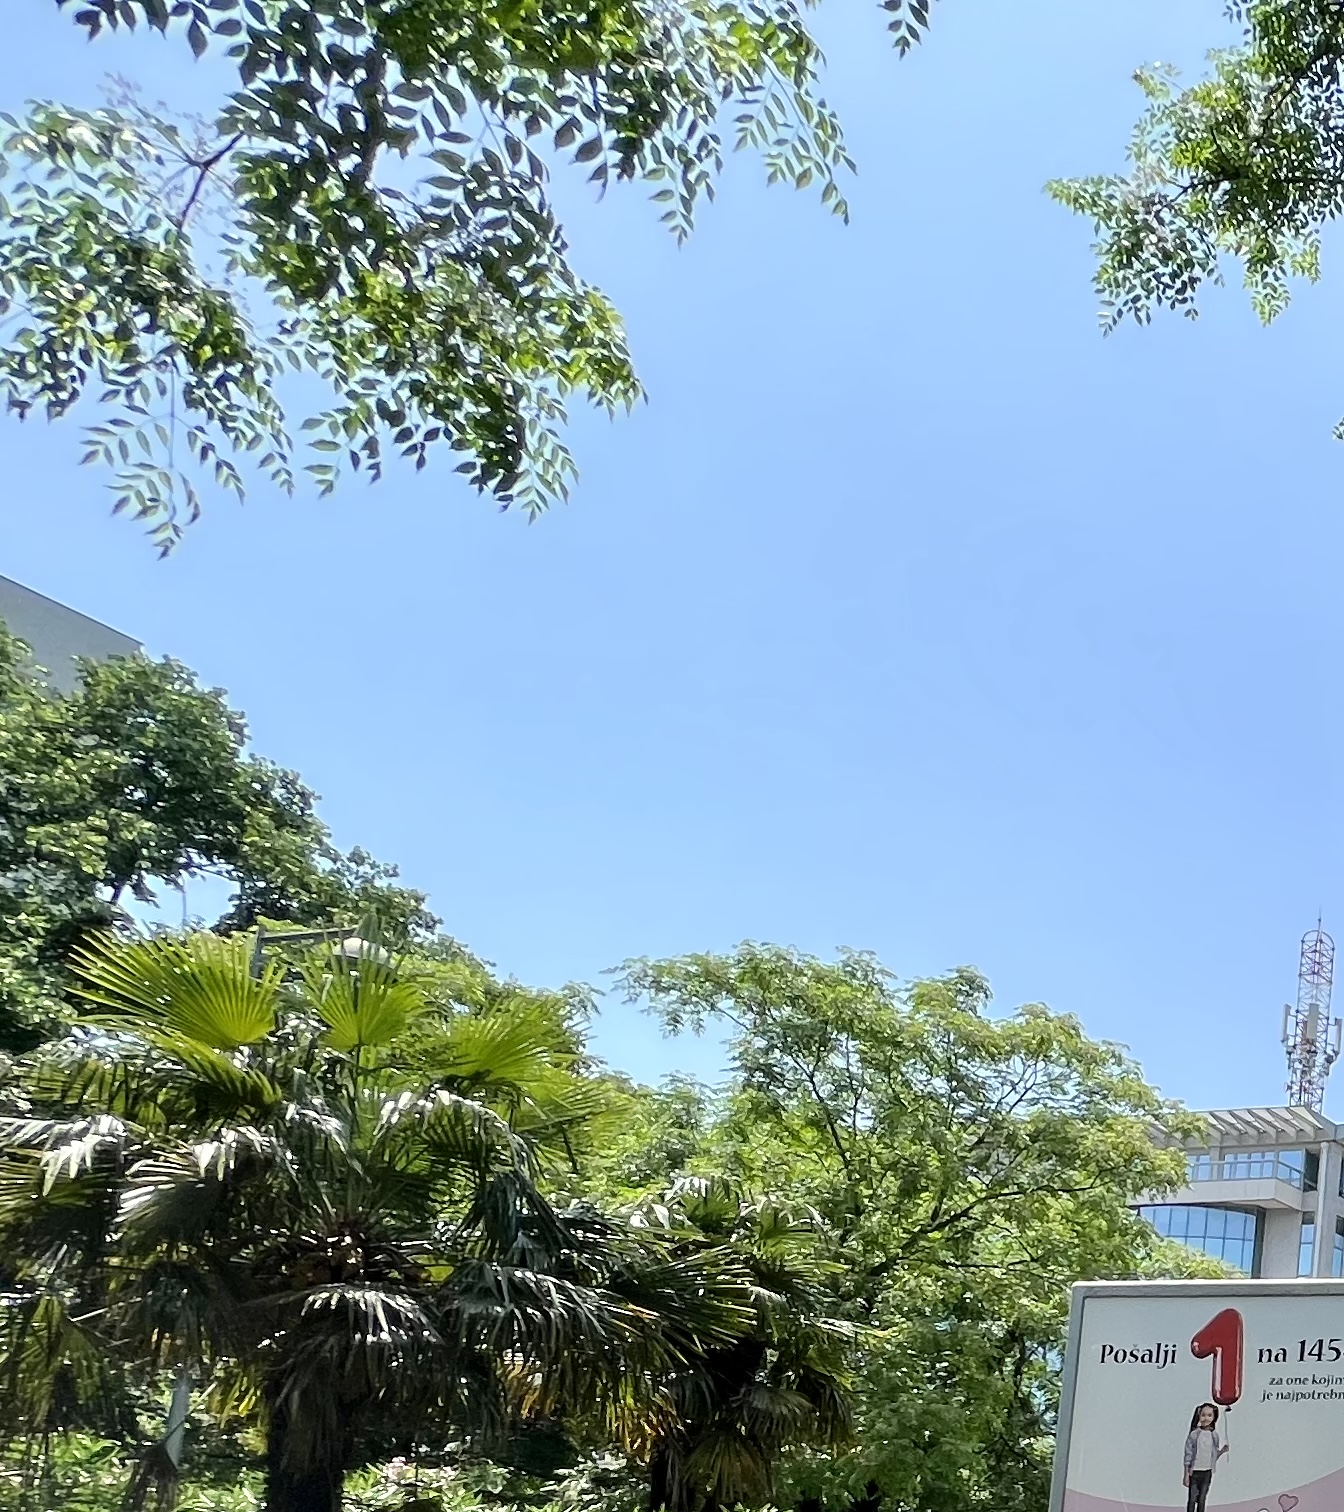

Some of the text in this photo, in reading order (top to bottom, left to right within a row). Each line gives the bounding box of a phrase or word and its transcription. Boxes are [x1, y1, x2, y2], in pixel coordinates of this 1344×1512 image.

[1100, 1342, 1178, 1370] Pošalji
[1190, 1307, 1244, 1406] 1
[1258, 1347, 1288, 1363] na
[1269, 1377, 1283, 1386] za
[1286, 1377, 1309, 1386] one
[1259, 1389, 1274, 1403] je
